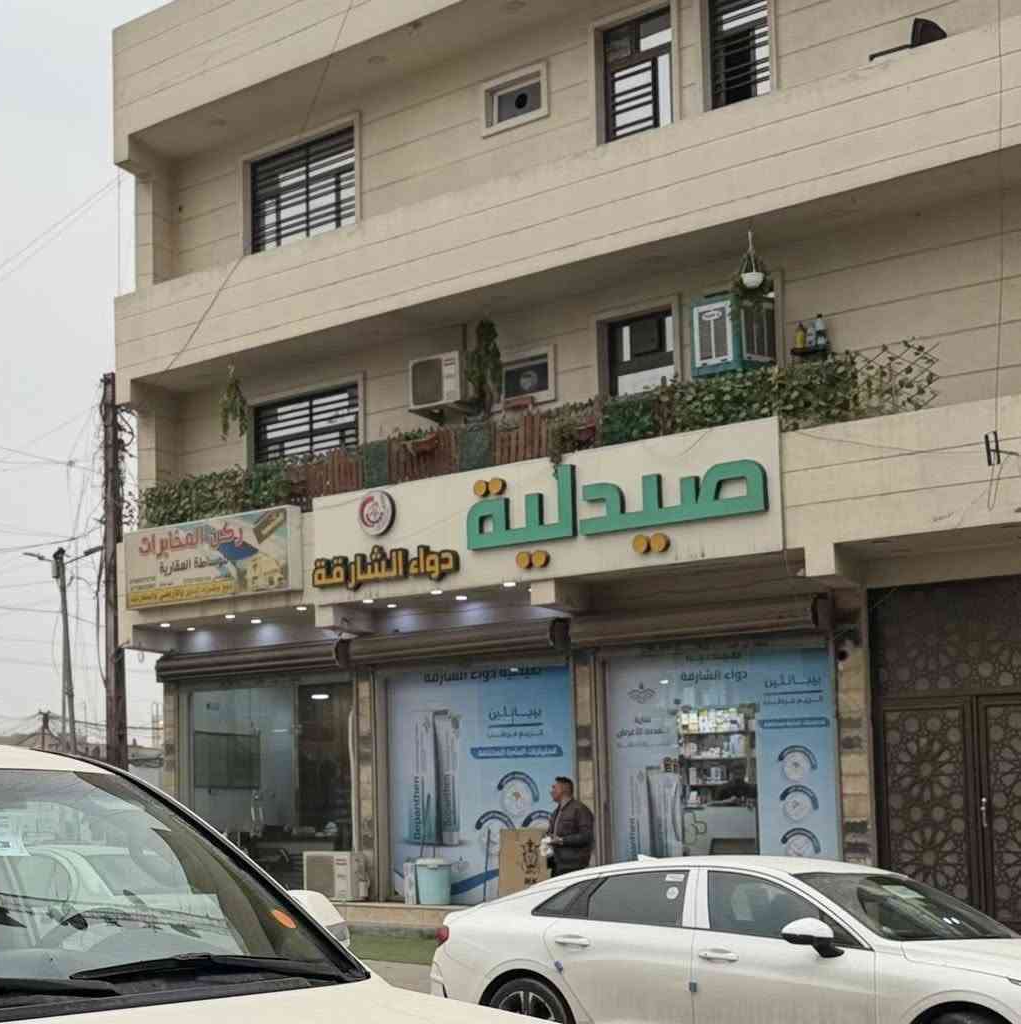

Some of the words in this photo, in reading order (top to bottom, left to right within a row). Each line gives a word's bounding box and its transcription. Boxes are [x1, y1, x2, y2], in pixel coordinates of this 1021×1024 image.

[466, 459, 769, 569] صيدلية
[313, 545, 409, 591] الشارقة
[409, 546, 459, 580] دواء
